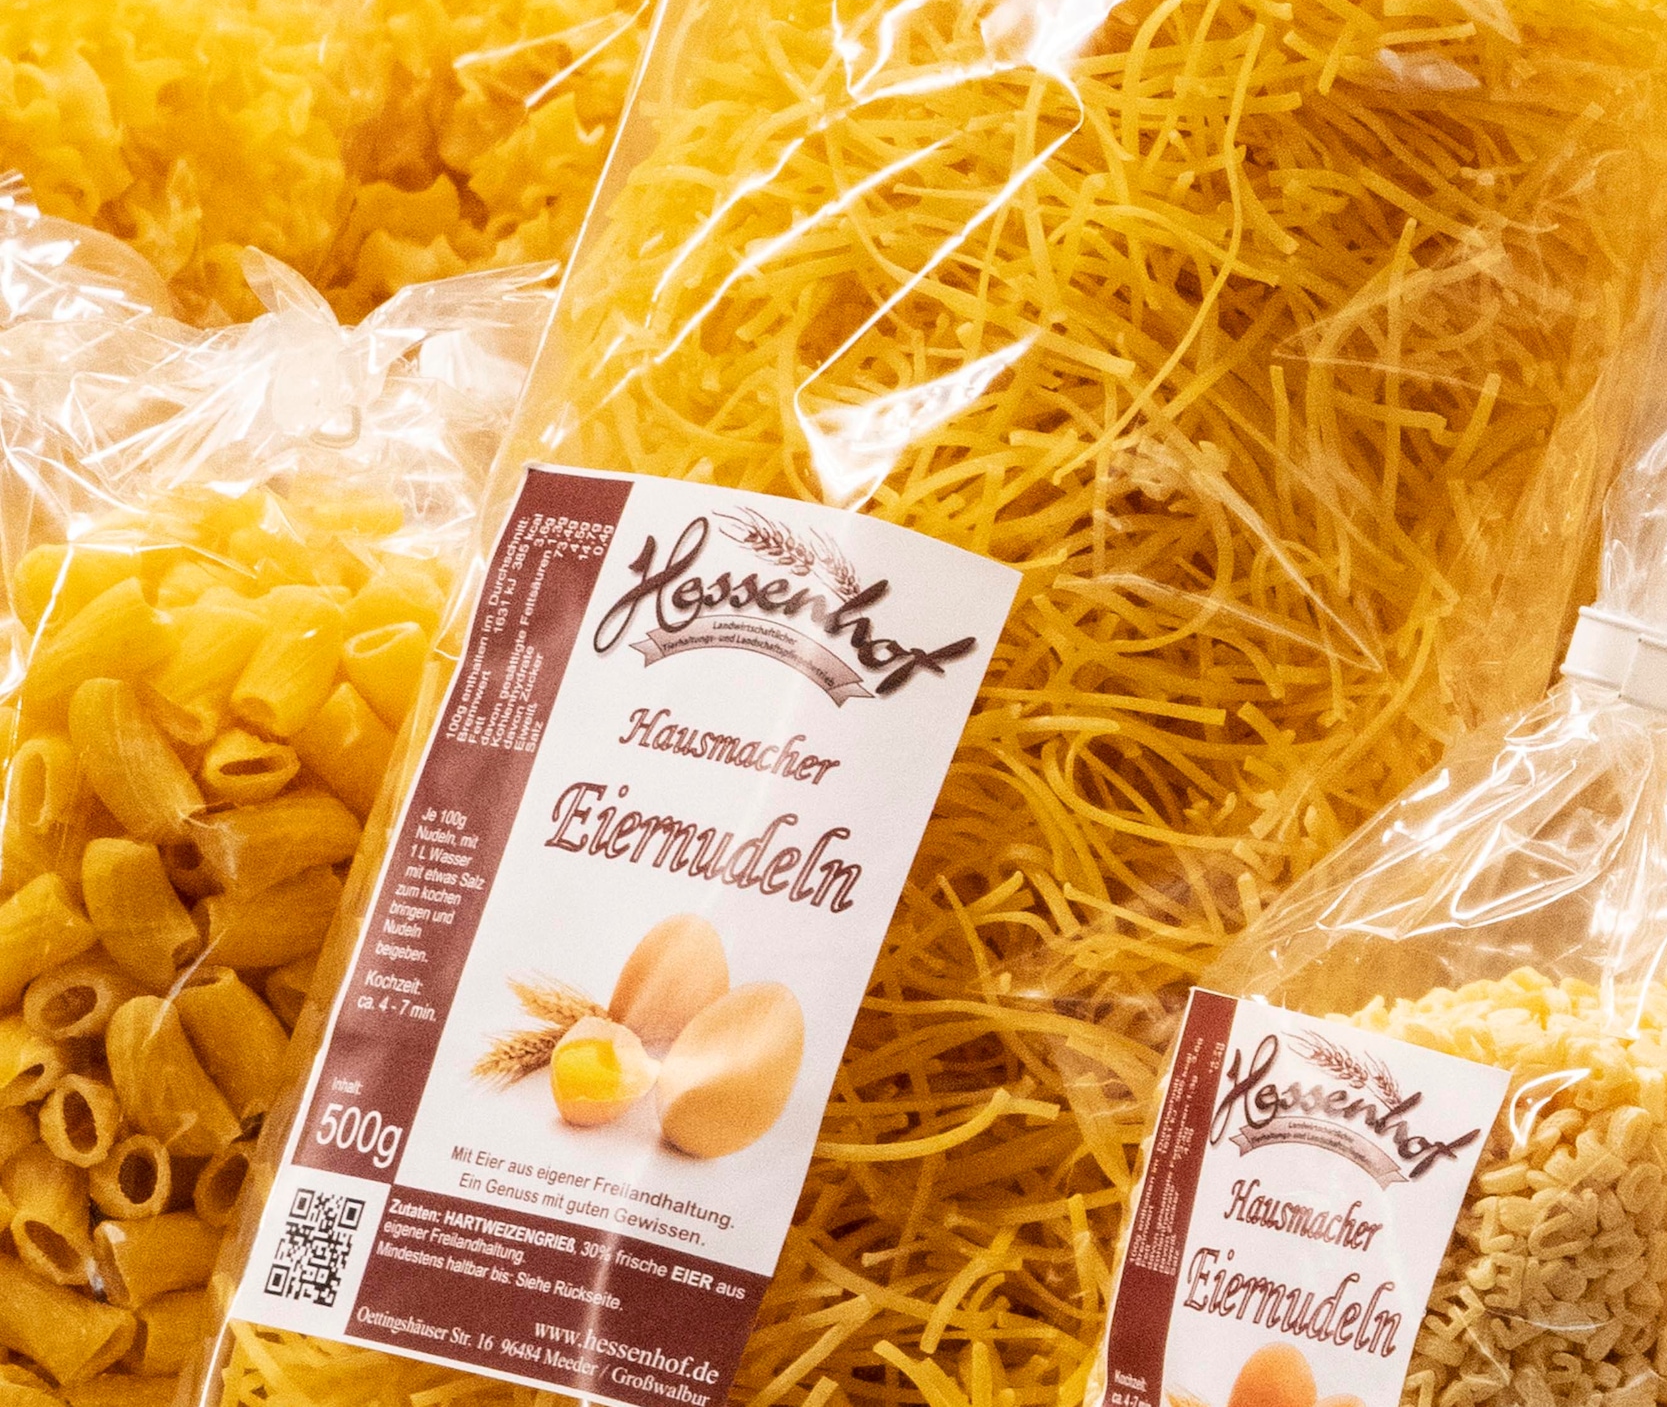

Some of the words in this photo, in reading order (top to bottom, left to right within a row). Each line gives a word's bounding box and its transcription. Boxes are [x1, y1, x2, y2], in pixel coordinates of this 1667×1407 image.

[594, 515, 978, 695] Hessenhof
[618, 707, 841, 786] Hausmacher
[422, 807, 437, 822] Je
[441, 809, 467, 829] 100g
[460, 835, 478, 849] mit
[544, 779, 862, 914] Eiernudeln
[406, 864, 423, 878] mit
[425, 869, 457, 886] etwas
[461, 872, 486, 890] Salz
[430, 849, 472, 866] Wasser
[389, 901, 430, 921] bringen
[433, 909, 455, 924] und
[395, 884, 419, 897] zum
[421, 887, 461, 905] kochen
[383, 919, 422, 937] Nudeln
[379, 997, 389, 1011] 4
[399, 999, 410, 1014] 7
[410, 1004, 437, 1021] min.
[316, 1102, 403, 1169] 500g
[1208, 1034, 1482, 1179] Hessenhof
[451, 1145, 473, 1164] Mit
[476, 1150, 502, 1171] Eier
[508, 1161, 533, 1177] aus
[536, 1166, 591, 1189] eigener
[593, 1176, 734, 1230] Freilandhaltung.
[459, 1172, 482, 1190] Ein
[485, 1174, 538, 1203] Genuss
[542, 1193, 564, 1209] mit
[567, 1199, 609, 1219] guten
[614, 1208, 706, 1247] Gewissen.
[1223, 1179, 1383, 1252] Hausmacher
[383, 1220, 428, 1241] eigener
[388, 1198, 441, 1225] Zutaten:
[580, 1241, 612, 1262] 30%
[615, 1250, 668, 1278] frische
[671, 1265, 714, 1290] EIER
[716, 1281, 747, 1300] aus
[376, 1240, 445, 1270] Mindestens
[446, 1256, 489, 1279] haltbar
[515, 1271, 551, 1293] Siehe
[1183, 1247, 1402, 1358] Eiernudeln
[450, 1327, 472, 1347] Str.
[477, 1332, 493, 1351] 16
[500, 1338, 542, 1361] 96484
[543, 1349, 599, 1376] Meeder
[611, 1365, 710, 1407] Großwalbur
[534, 1322, 719, 1385] www.hessenhof.de
